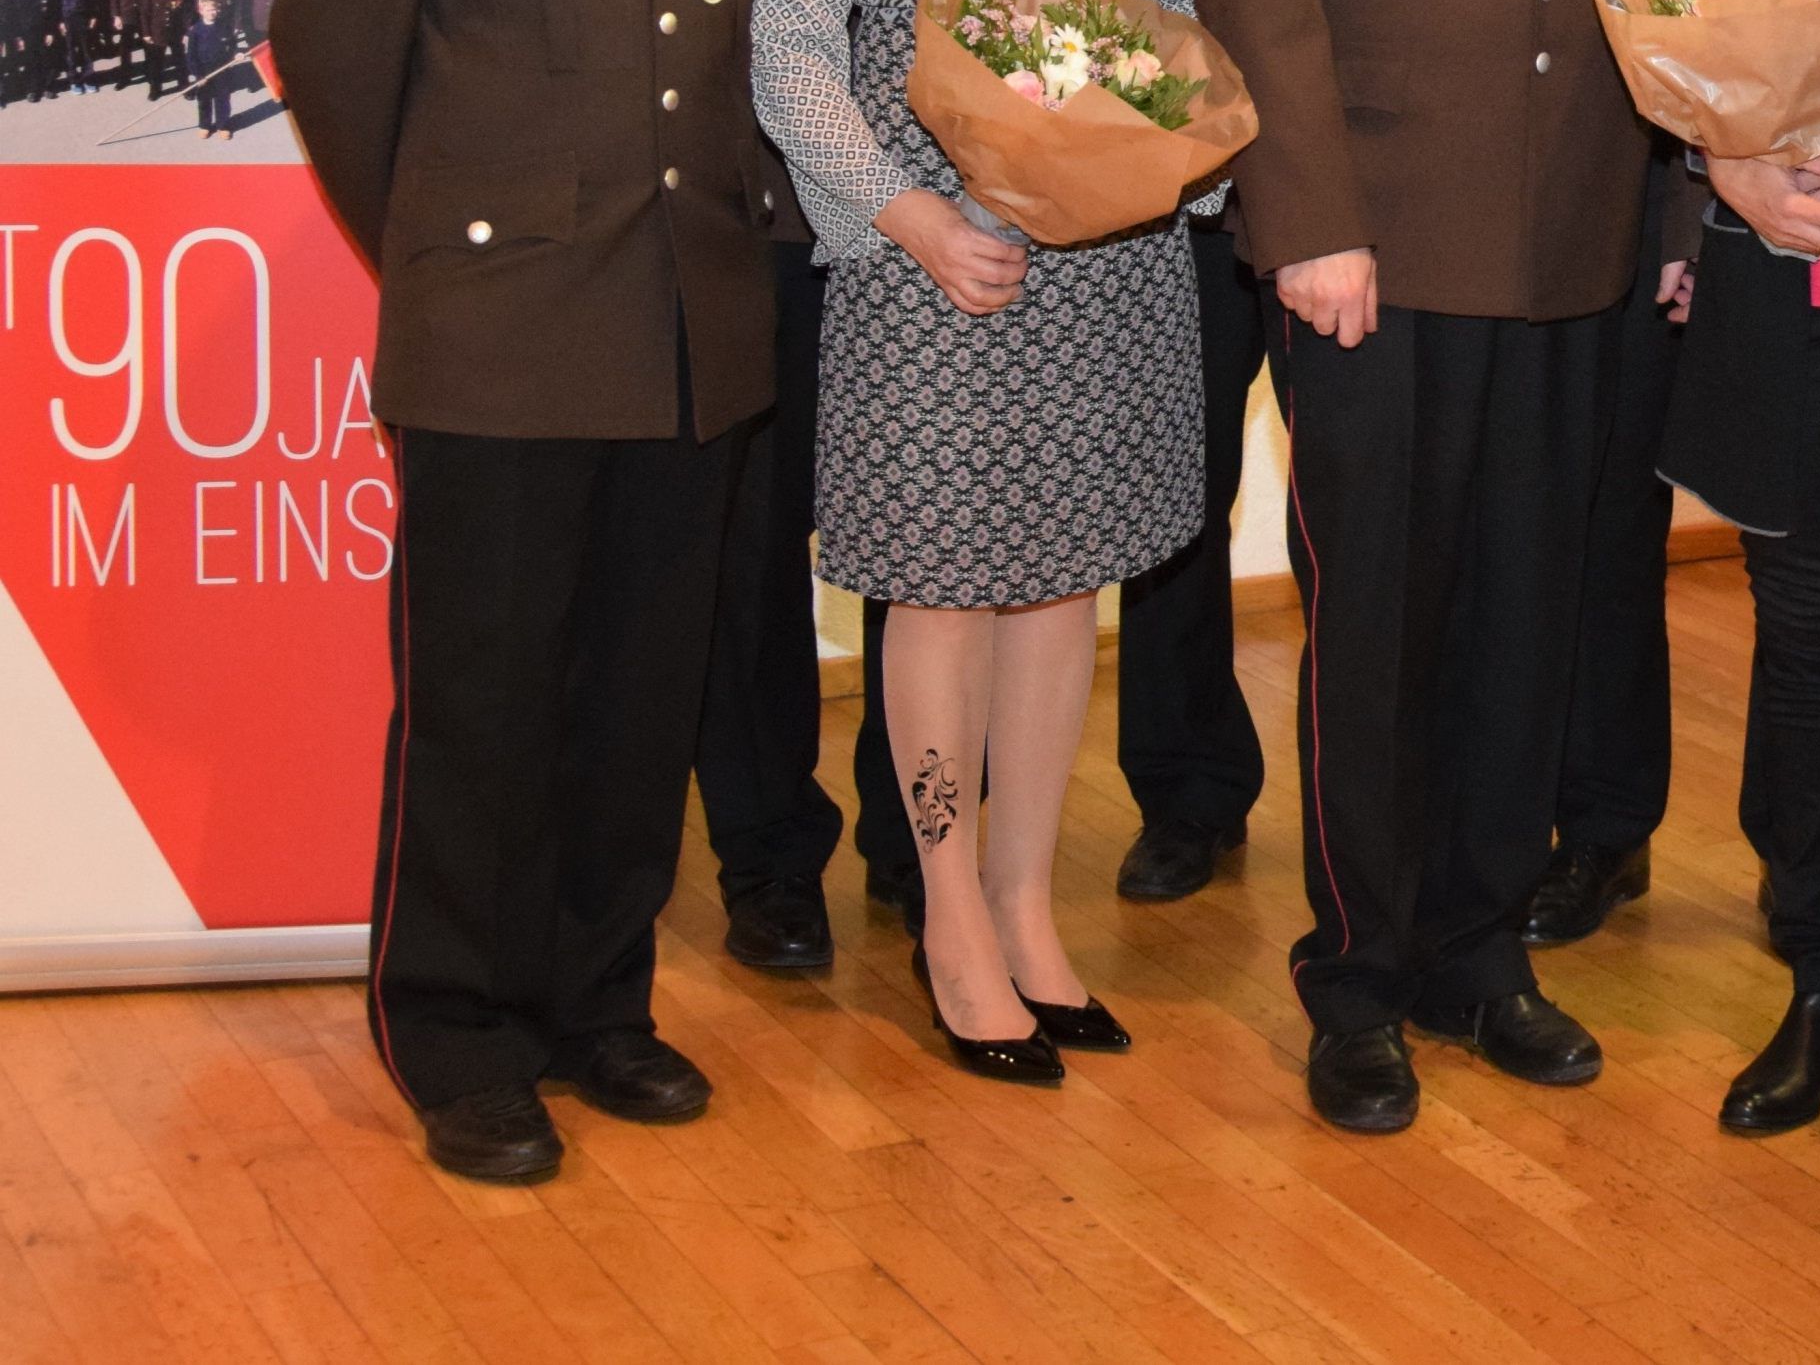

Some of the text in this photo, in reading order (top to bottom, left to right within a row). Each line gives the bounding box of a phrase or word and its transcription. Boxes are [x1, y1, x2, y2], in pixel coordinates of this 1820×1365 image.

[49, 227, 271, 460] 90
[52, 477, 394, 588] IM EINS
